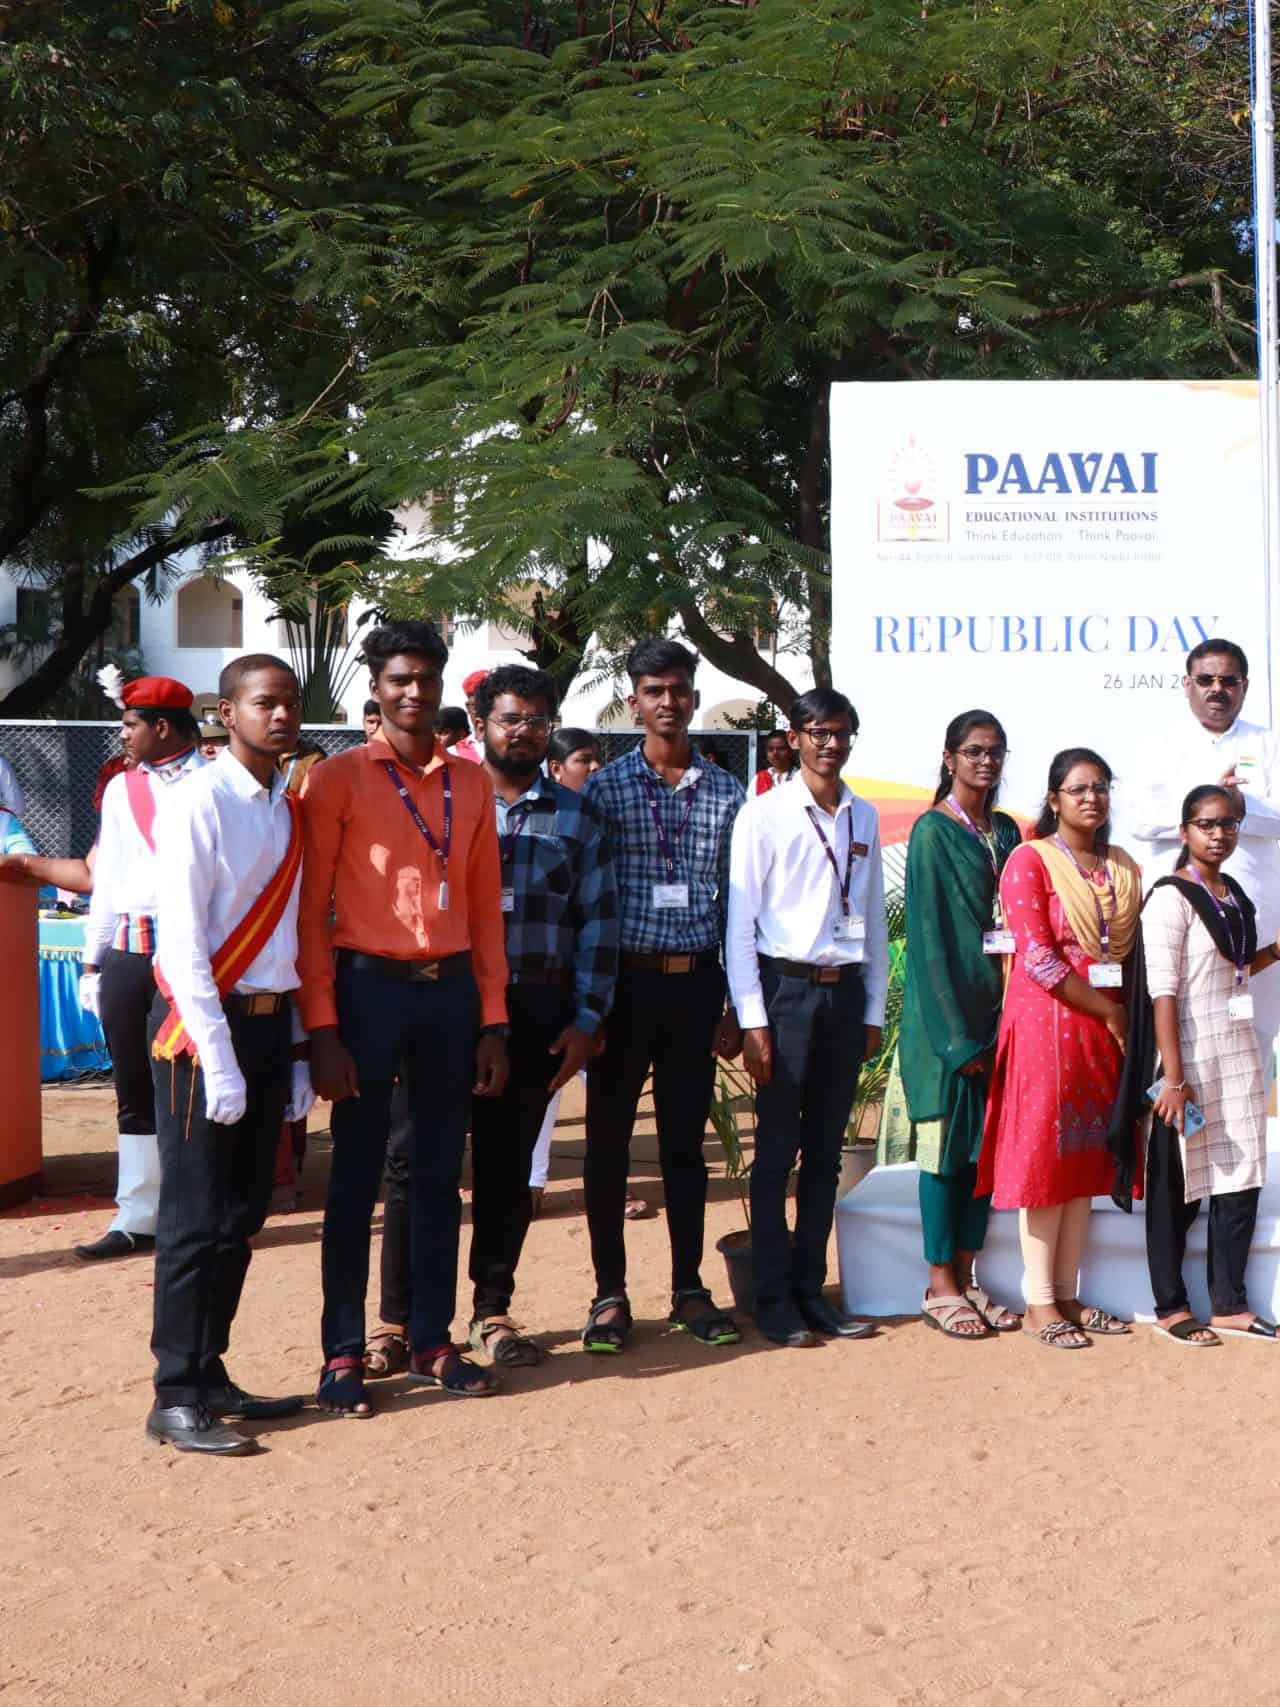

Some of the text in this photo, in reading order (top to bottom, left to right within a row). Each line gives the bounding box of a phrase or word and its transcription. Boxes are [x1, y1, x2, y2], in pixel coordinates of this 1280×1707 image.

[964, 452, 1159, 495] PAAVAI
[965, 511, 1159, 523] EDUCATIONAL INSTITUTIONS
[965, 529, 998, 542] Think
[1001, 529, 1063, 542] Education
[1079, 528, 1112, 541] Think
[873, 615, 1221, 653] REPUBLIC DAY
[1103, 673, 1123, 689] 26
[1129, 673, 1164, 689] JAN
